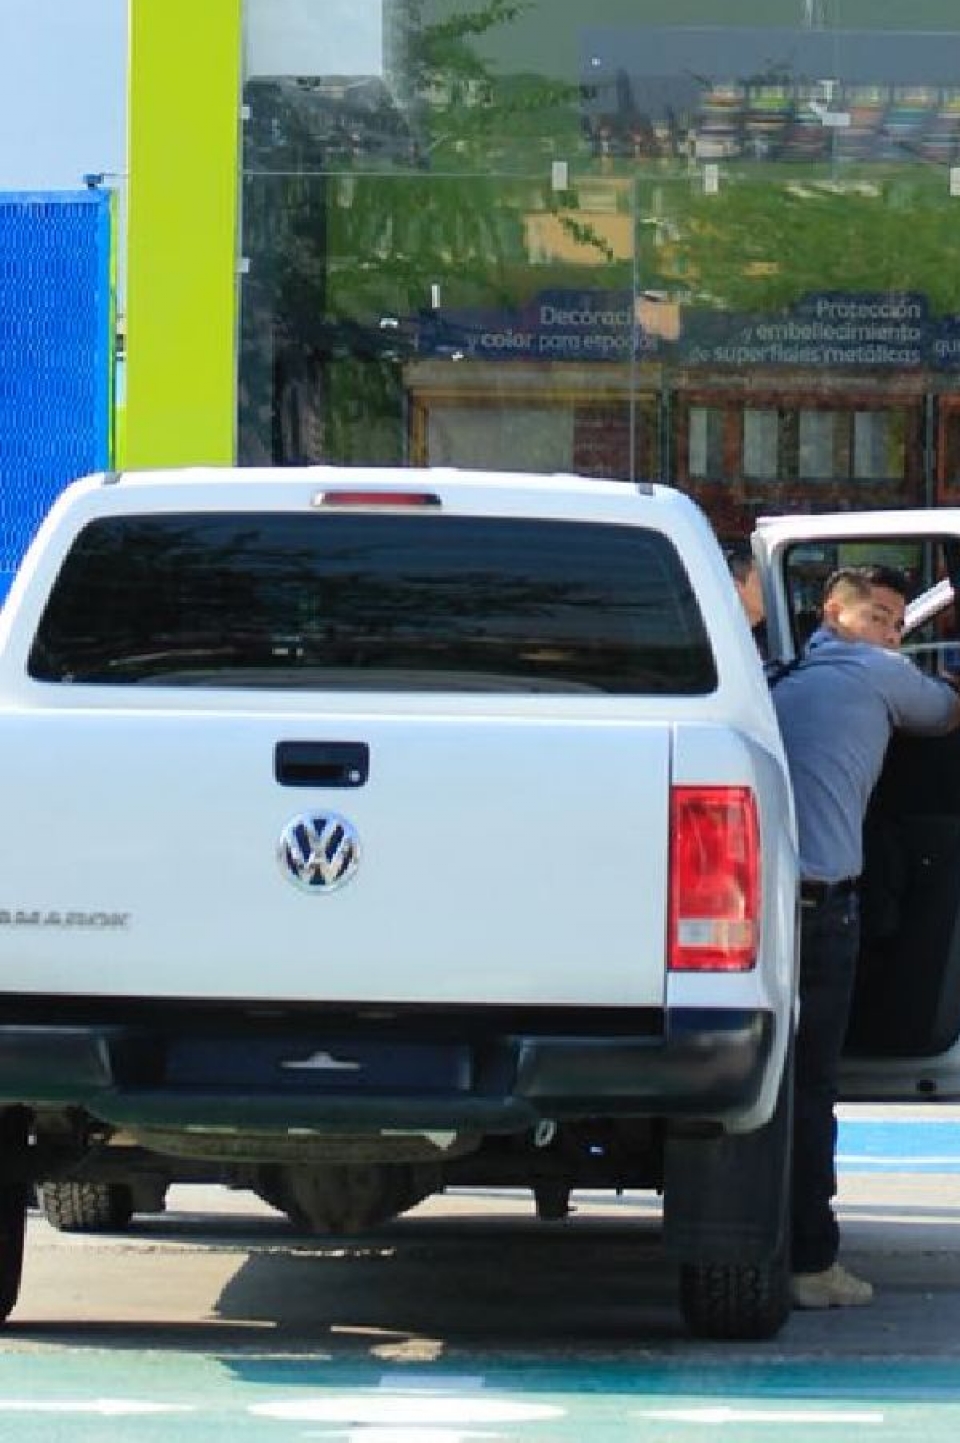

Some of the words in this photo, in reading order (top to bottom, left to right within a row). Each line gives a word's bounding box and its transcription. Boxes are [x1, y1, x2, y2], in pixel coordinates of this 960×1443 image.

[540, 306, 636, 326] Decoraci
[816, 298, 921, 319] Protección
[481, 328, 534, 349] color
[757, 322, 921, 341] embellecimiento
